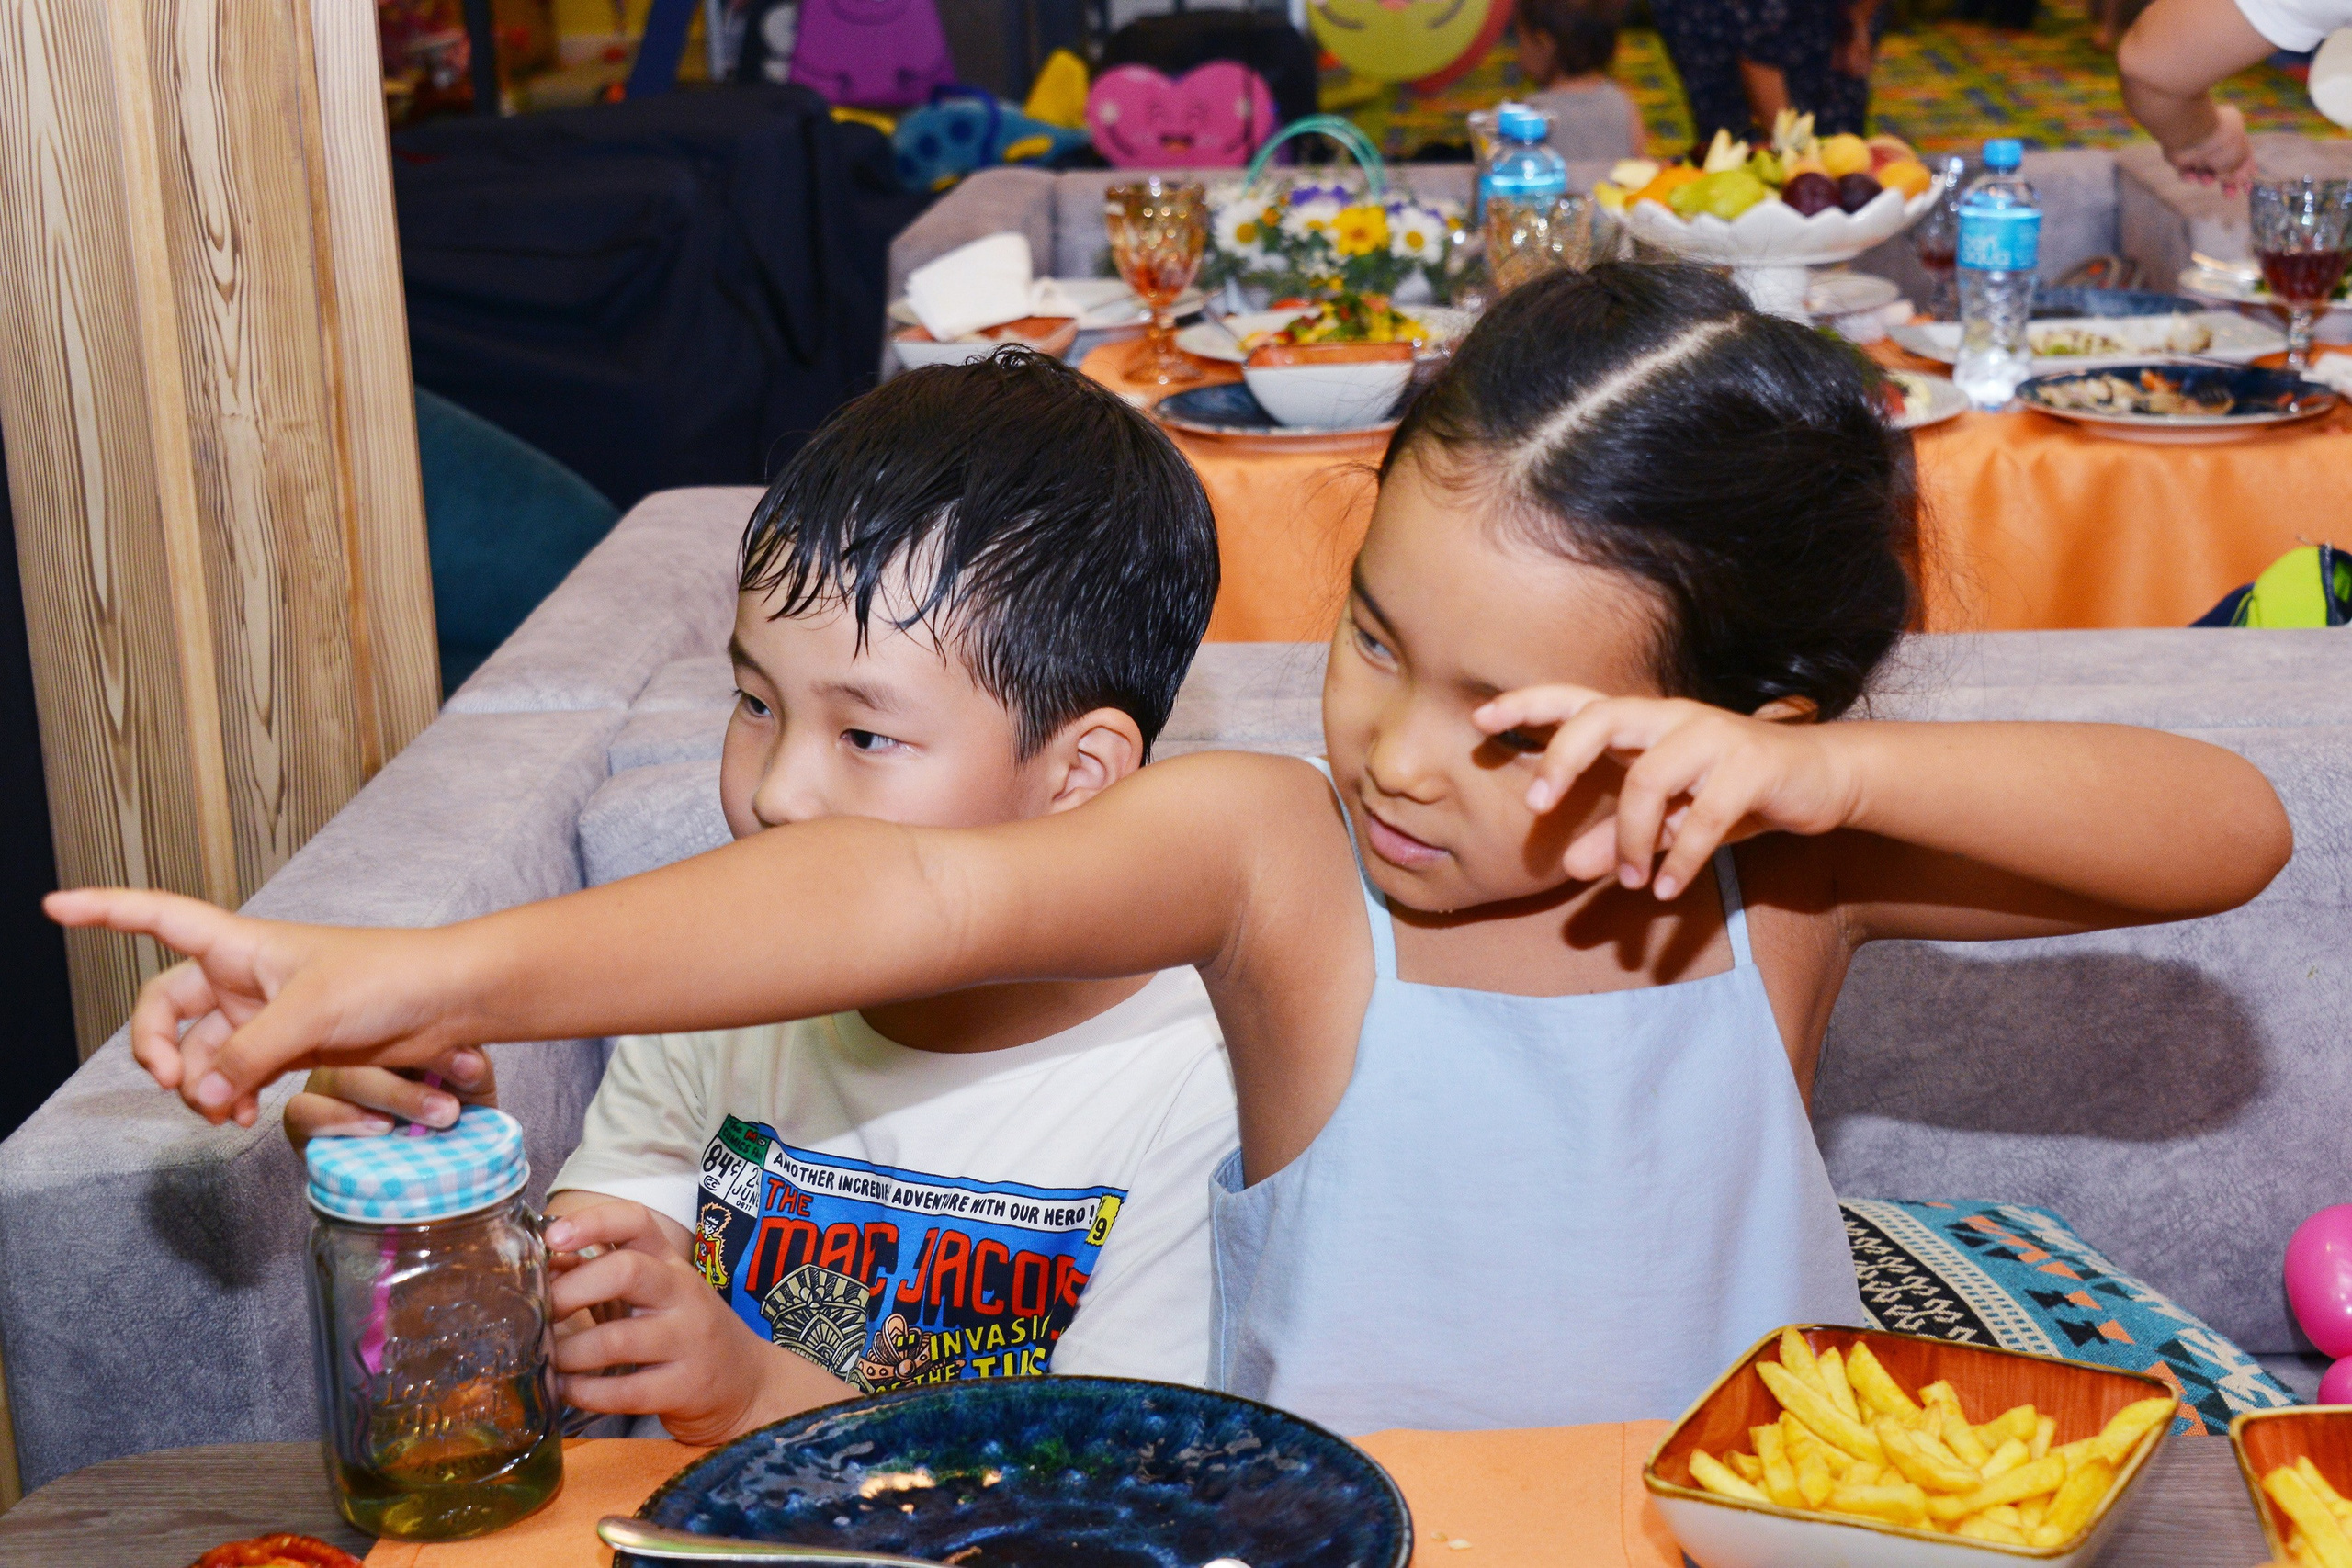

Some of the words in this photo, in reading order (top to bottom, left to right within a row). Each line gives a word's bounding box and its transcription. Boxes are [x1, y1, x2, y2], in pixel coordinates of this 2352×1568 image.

[722, 1127, 752, 1154] COMICS
[765, 1177, 813, 1217] THE
[773, 1152, 835, 1190] ANOTHER
[891, 1187, 970, 1213] ADVENTURE
[970, 1197, 1006, 1218] WITH
[1011, 1203, 1040, 1224] OUR
